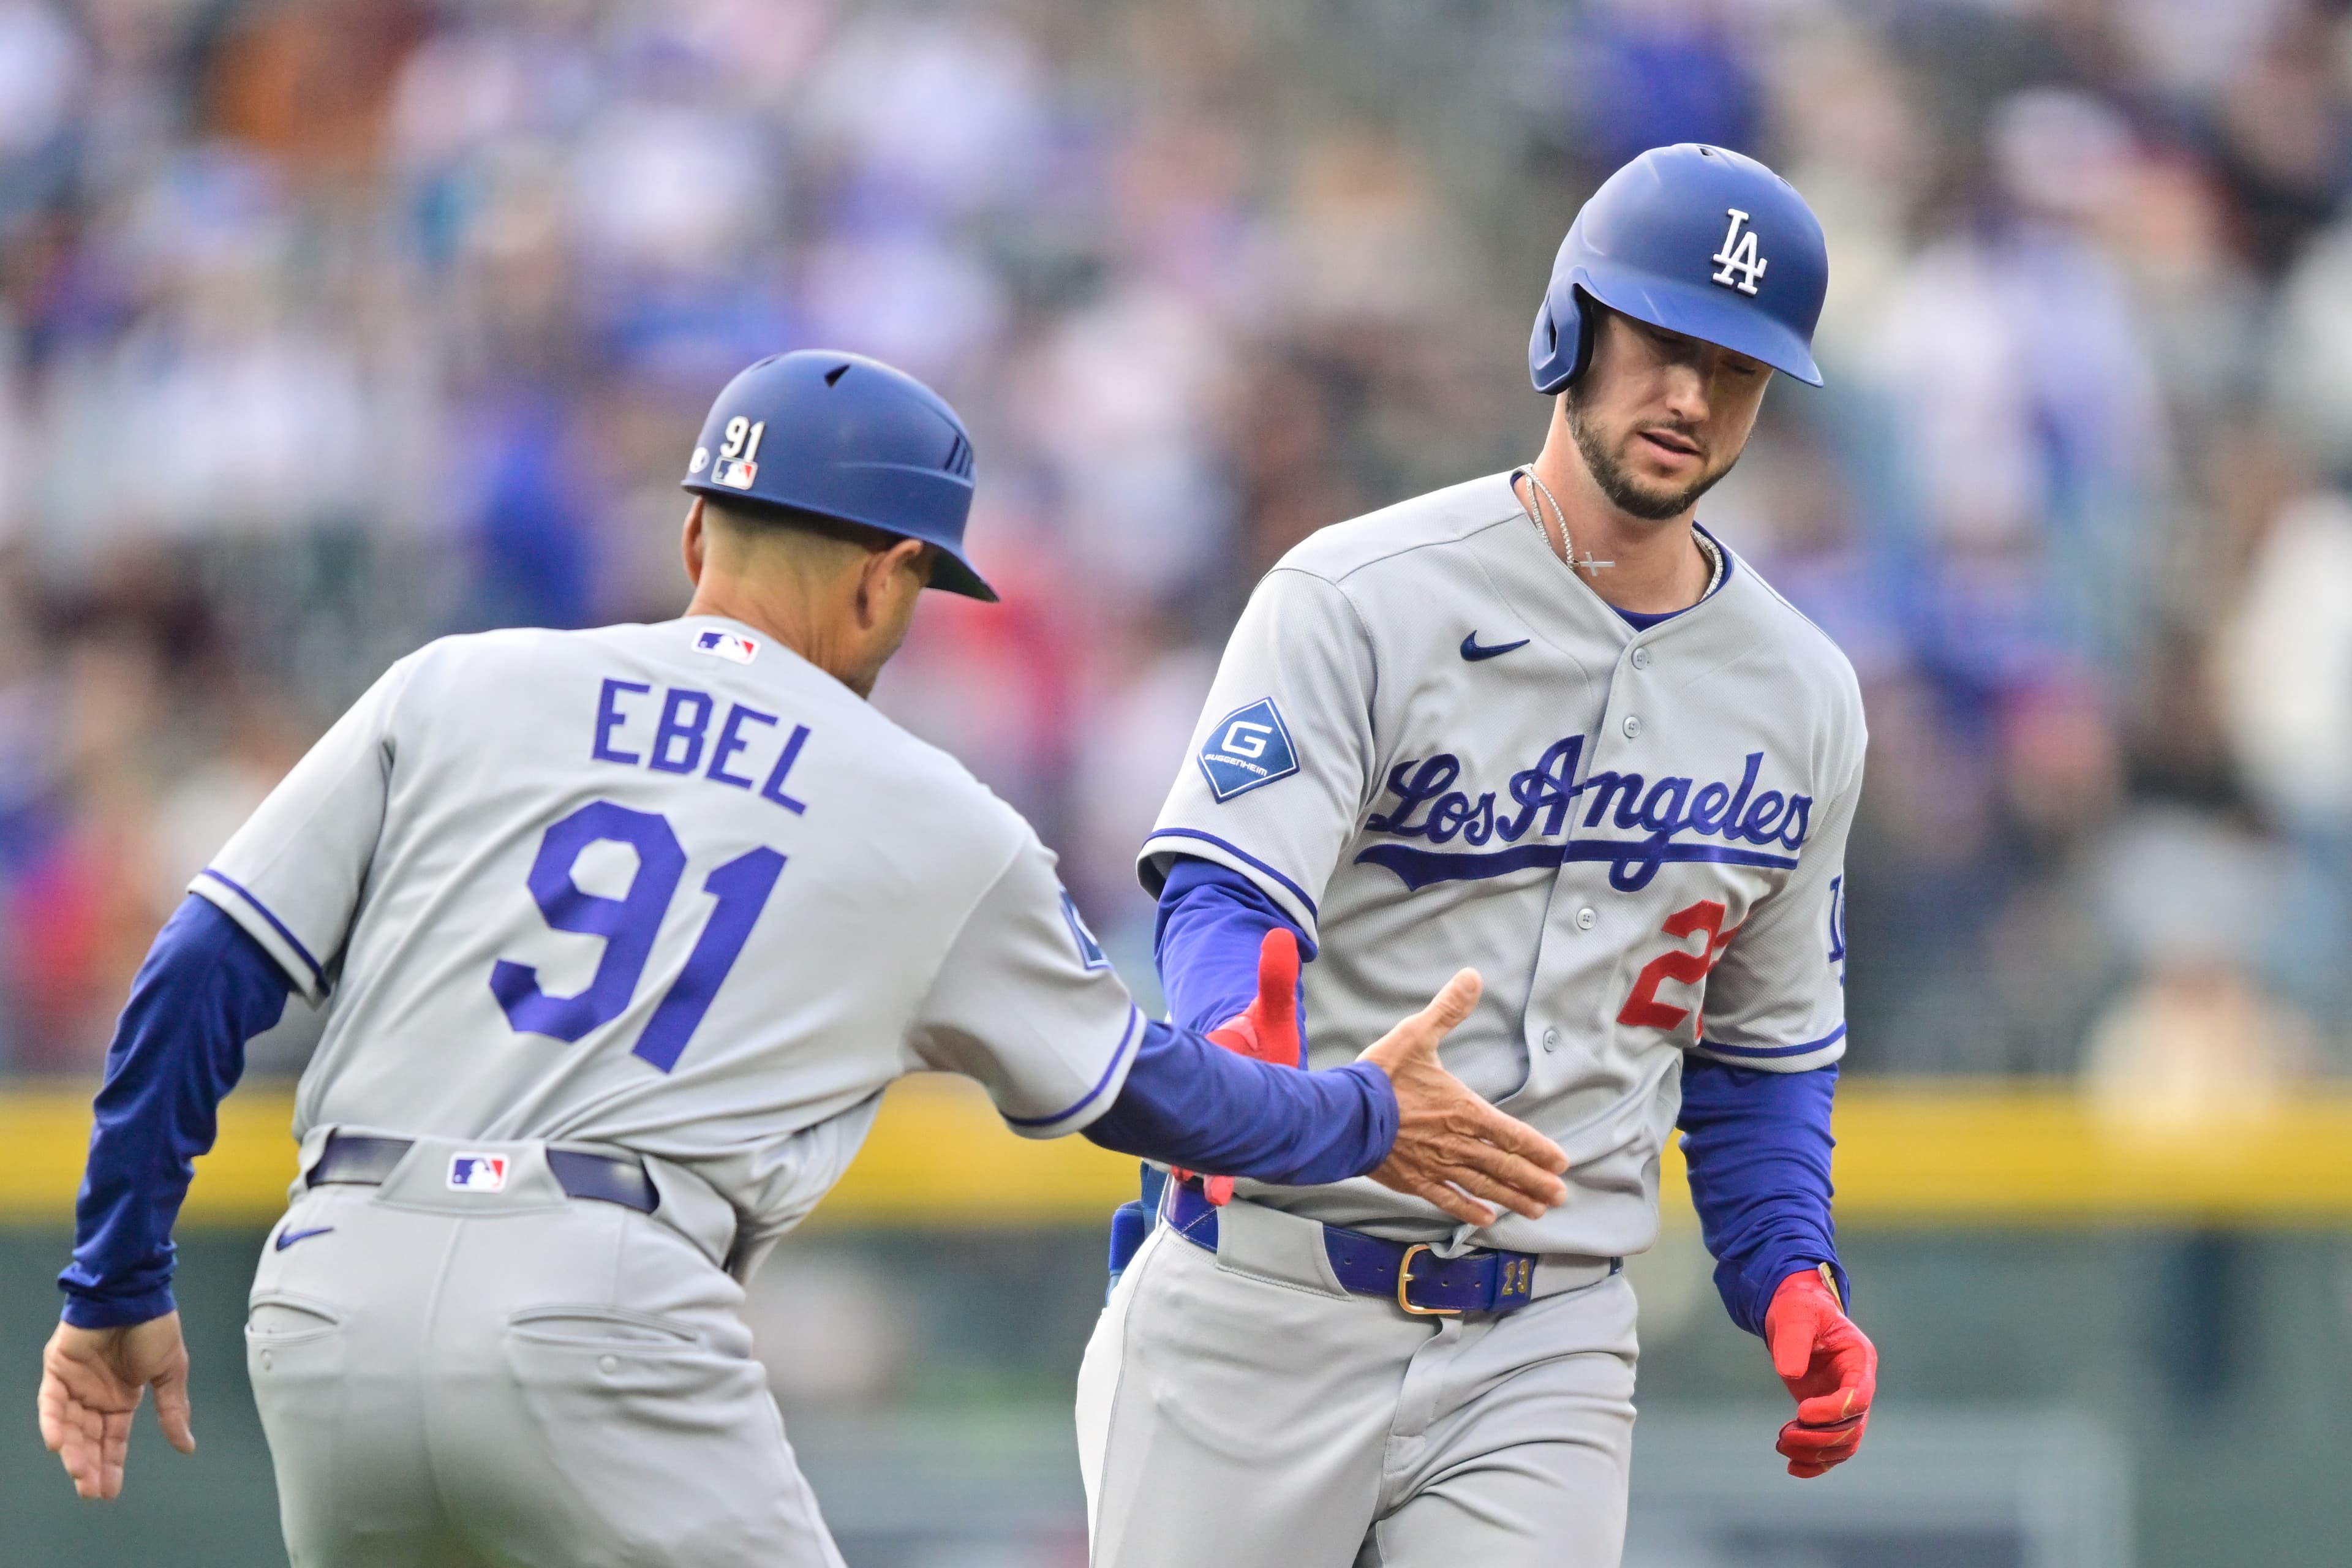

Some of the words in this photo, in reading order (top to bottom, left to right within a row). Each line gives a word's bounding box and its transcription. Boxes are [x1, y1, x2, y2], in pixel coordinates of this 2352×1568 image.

[1713, 208, 1768, 295] LA
[720, 415, 766, 462] 91
[592, 677, 812, 816] EBEL
[1205, 753, 1268, 777] GUGGENHEIM
[1221, 720, 1273, 758] G
[1367, 753, 1498, 846] Los
[1495, 734, 1814, 892] Angeles
[489, 799, 789, 1075] 91
[1616, 899, 1746, 1041] 2
[1502, 1259, 1529, 1295] 23
